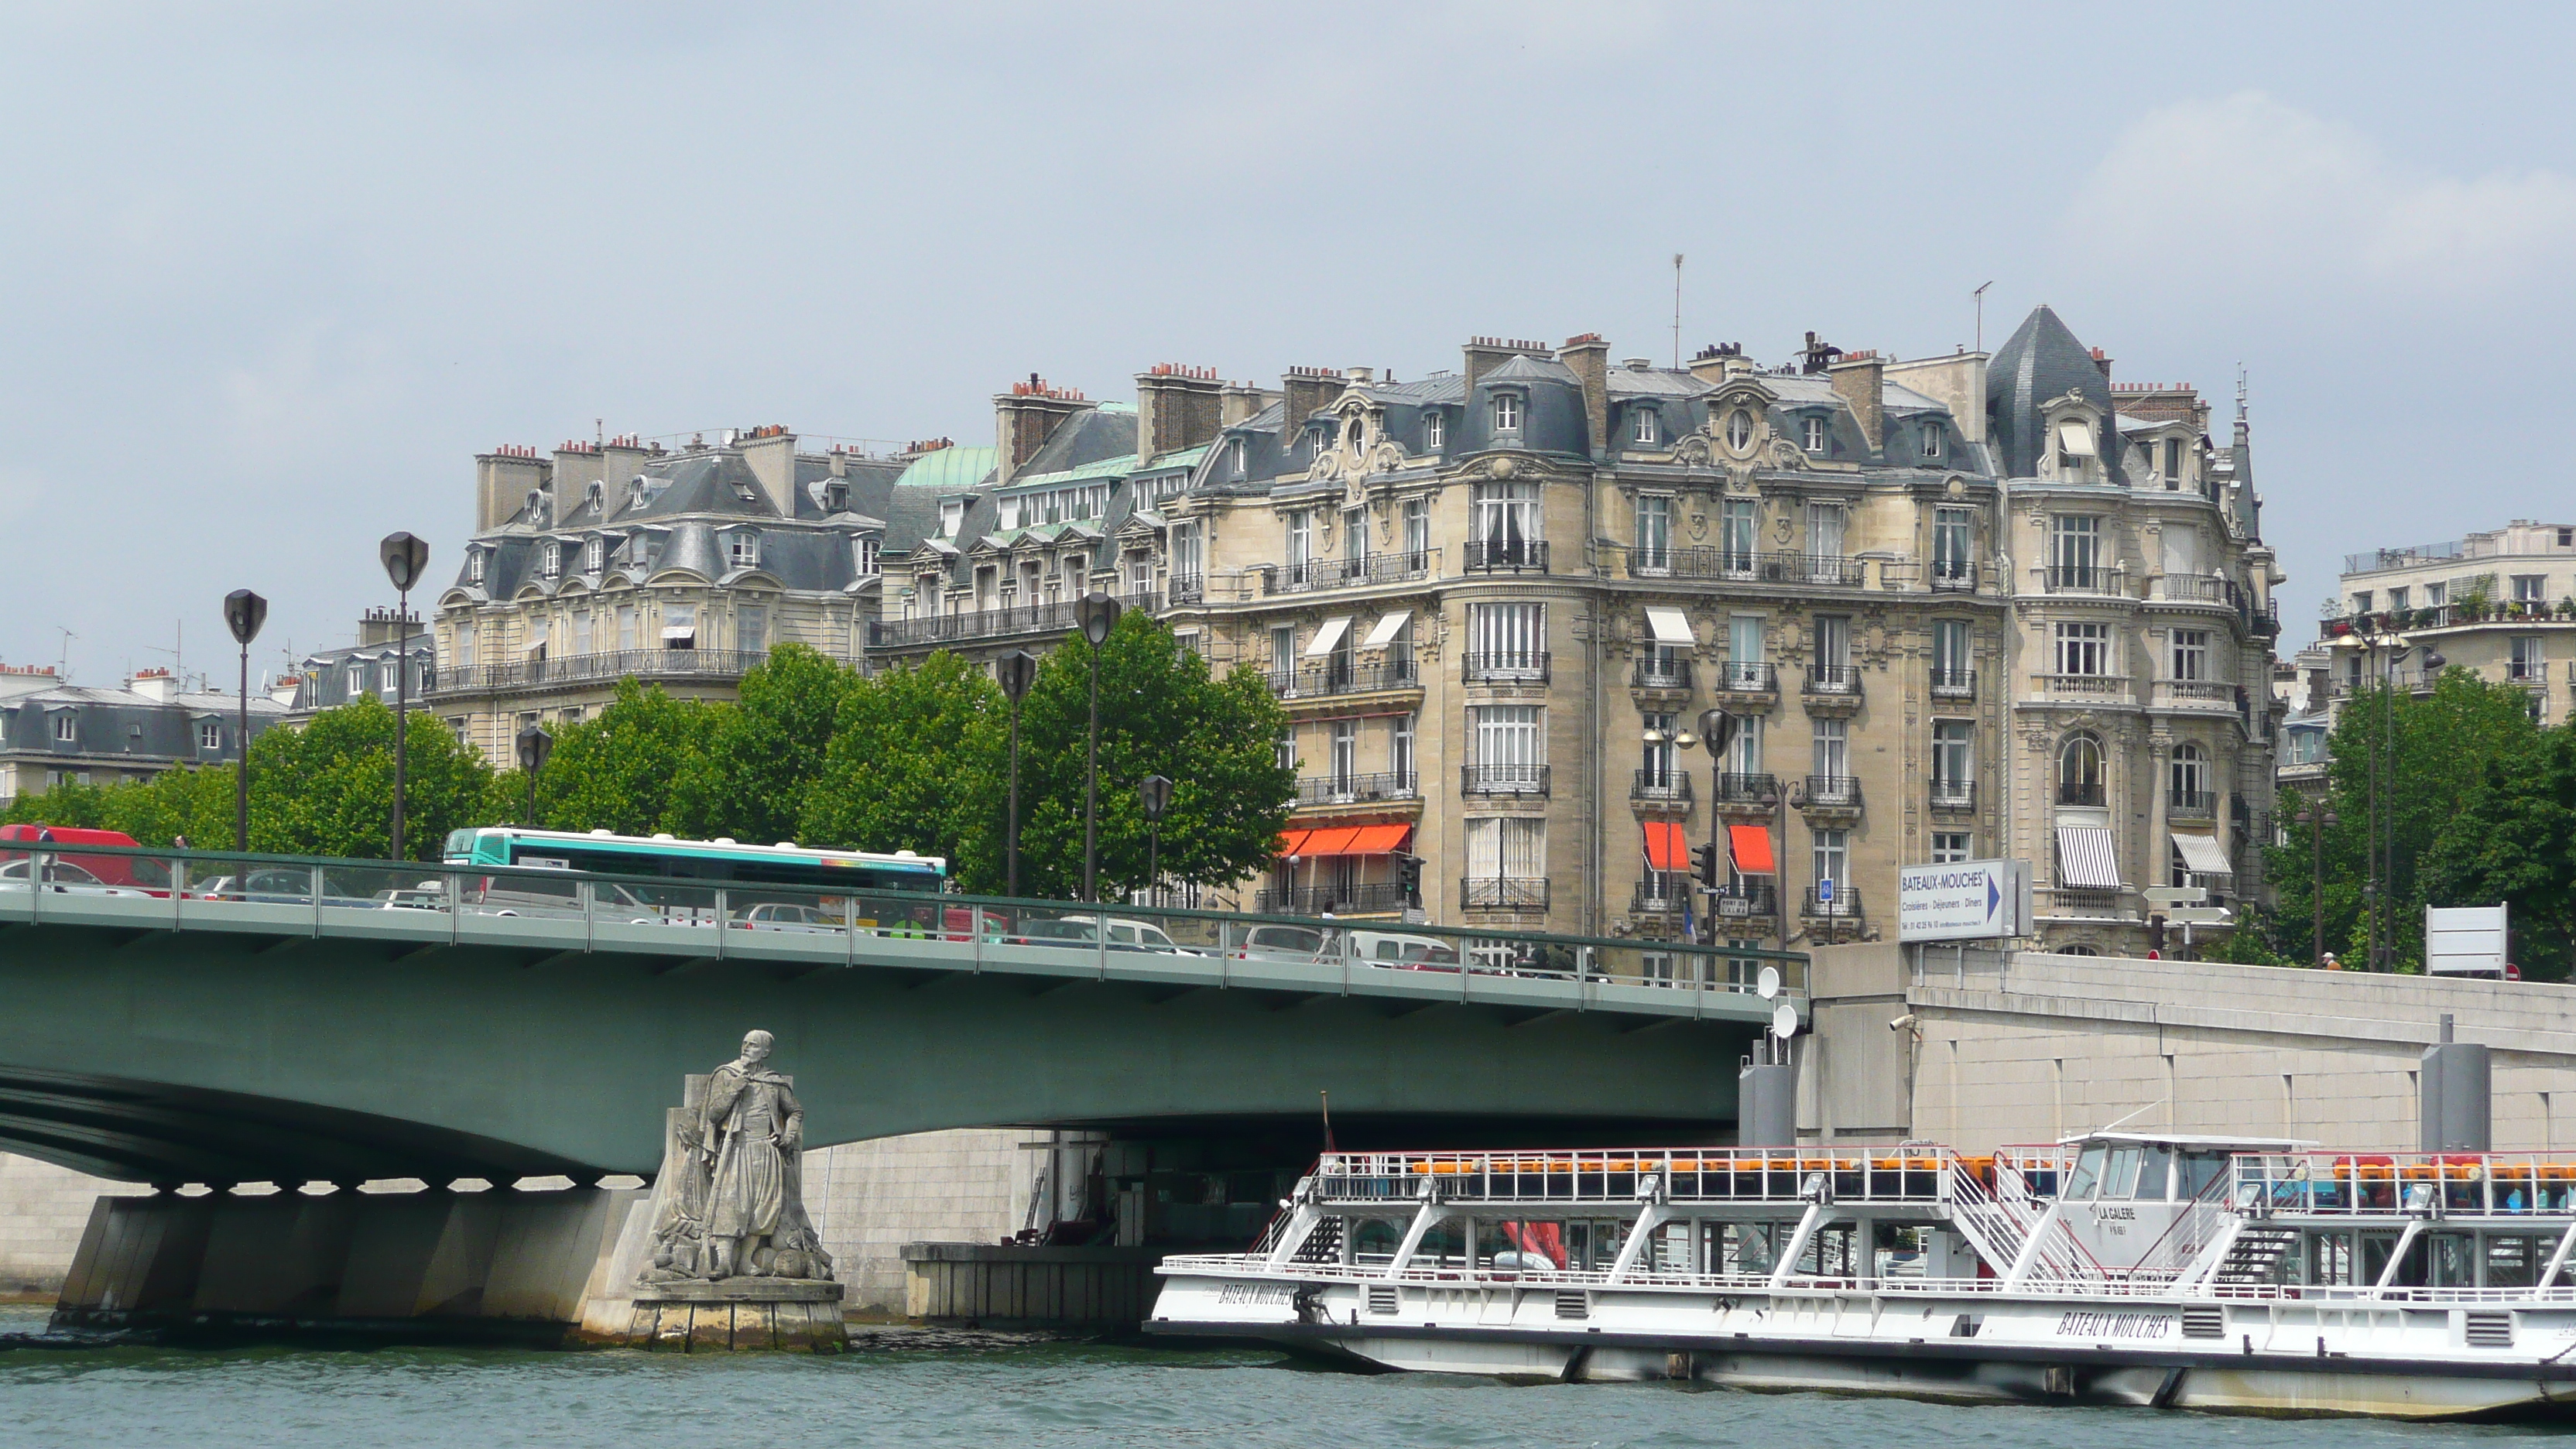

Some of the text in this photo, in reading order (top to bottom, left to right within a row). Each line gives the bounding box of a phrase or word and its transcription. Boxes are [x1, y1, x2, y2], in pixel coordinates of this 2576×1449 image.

[1902, 872, 1983, 892] BATEAUX-MOUCHES
[1902, 900, 1928, 912] Croisières
[1933, 899, 1960, 911] Déjeuners
[2098, 1208, 2136, 1220] LA GALERE
